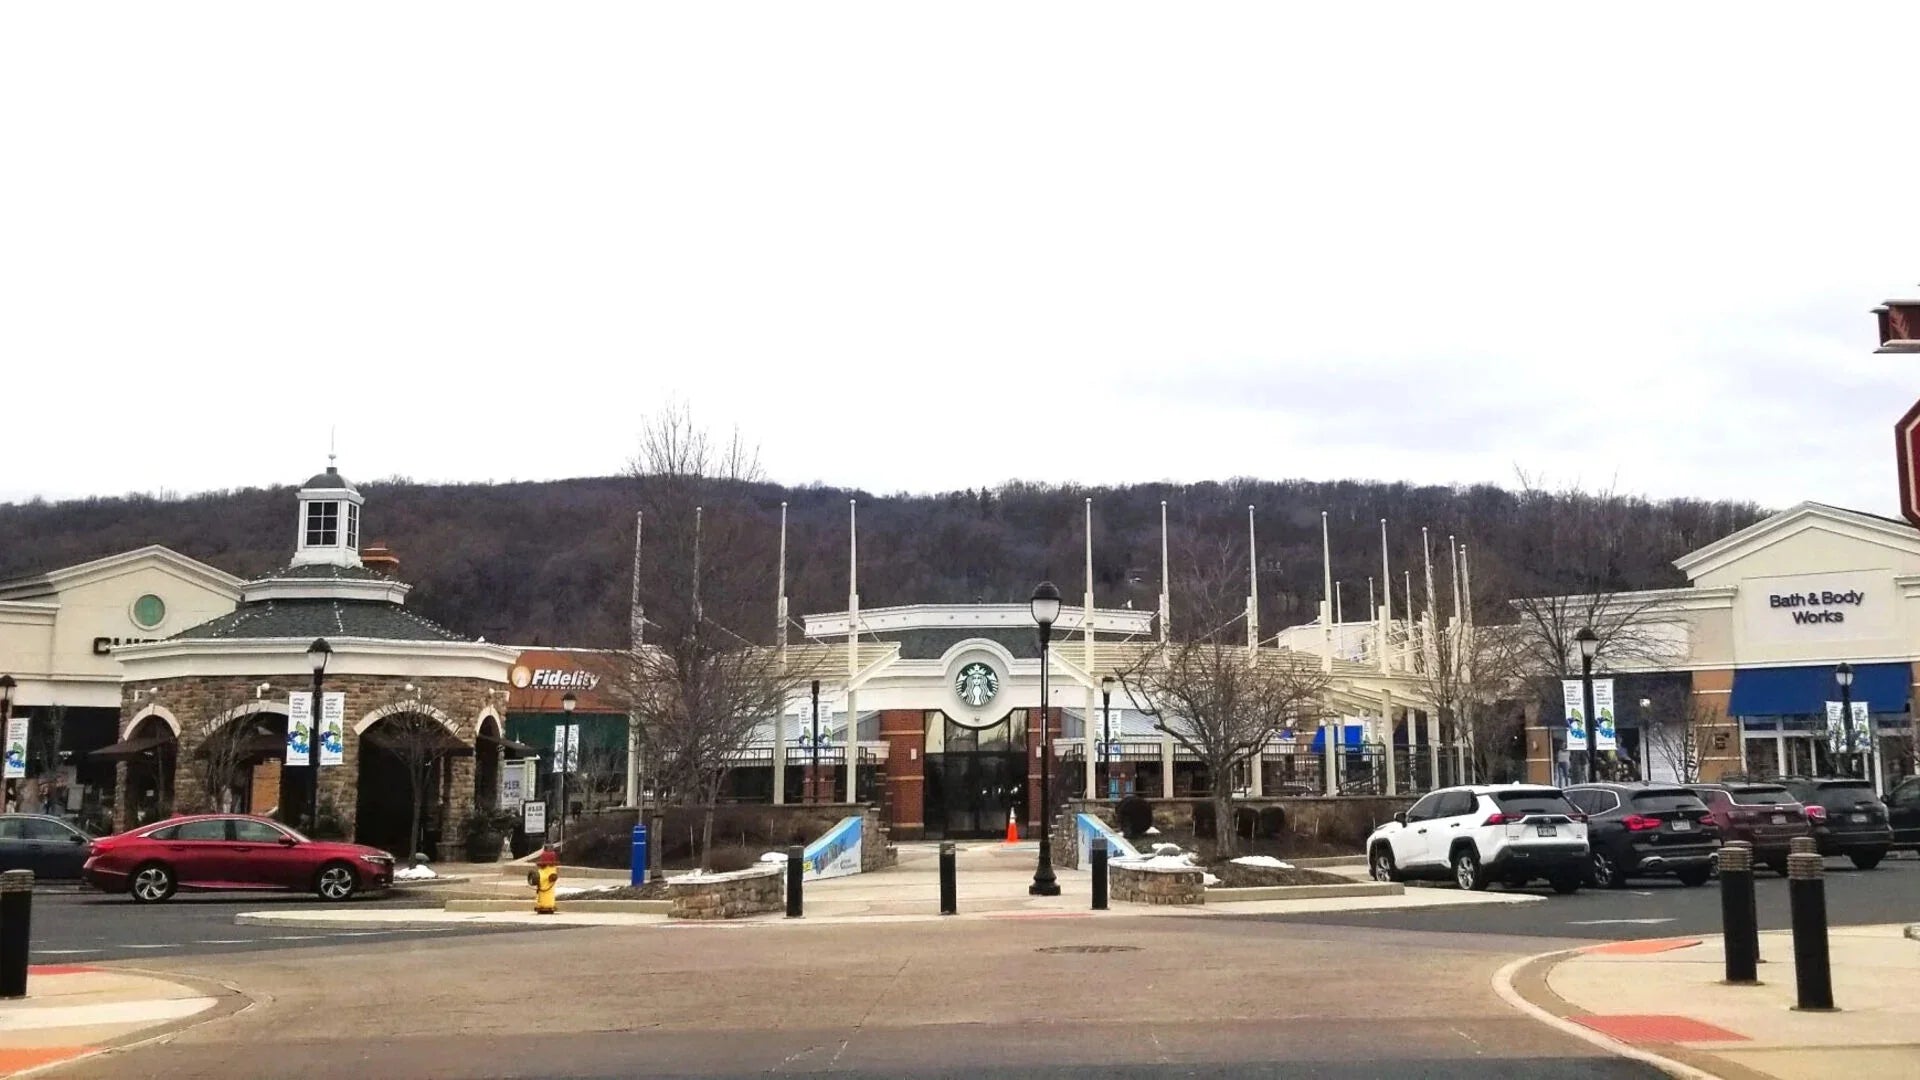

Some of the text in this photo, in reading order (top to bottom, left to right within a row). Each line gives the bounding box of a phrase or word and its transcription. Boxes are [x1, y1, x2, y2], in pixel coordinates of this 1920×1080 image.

[1769, 589, 1865, 608] Bath & Body
[1791, 609, 1845, 625] Works
[531, 669, 600, 690] Fidelity
